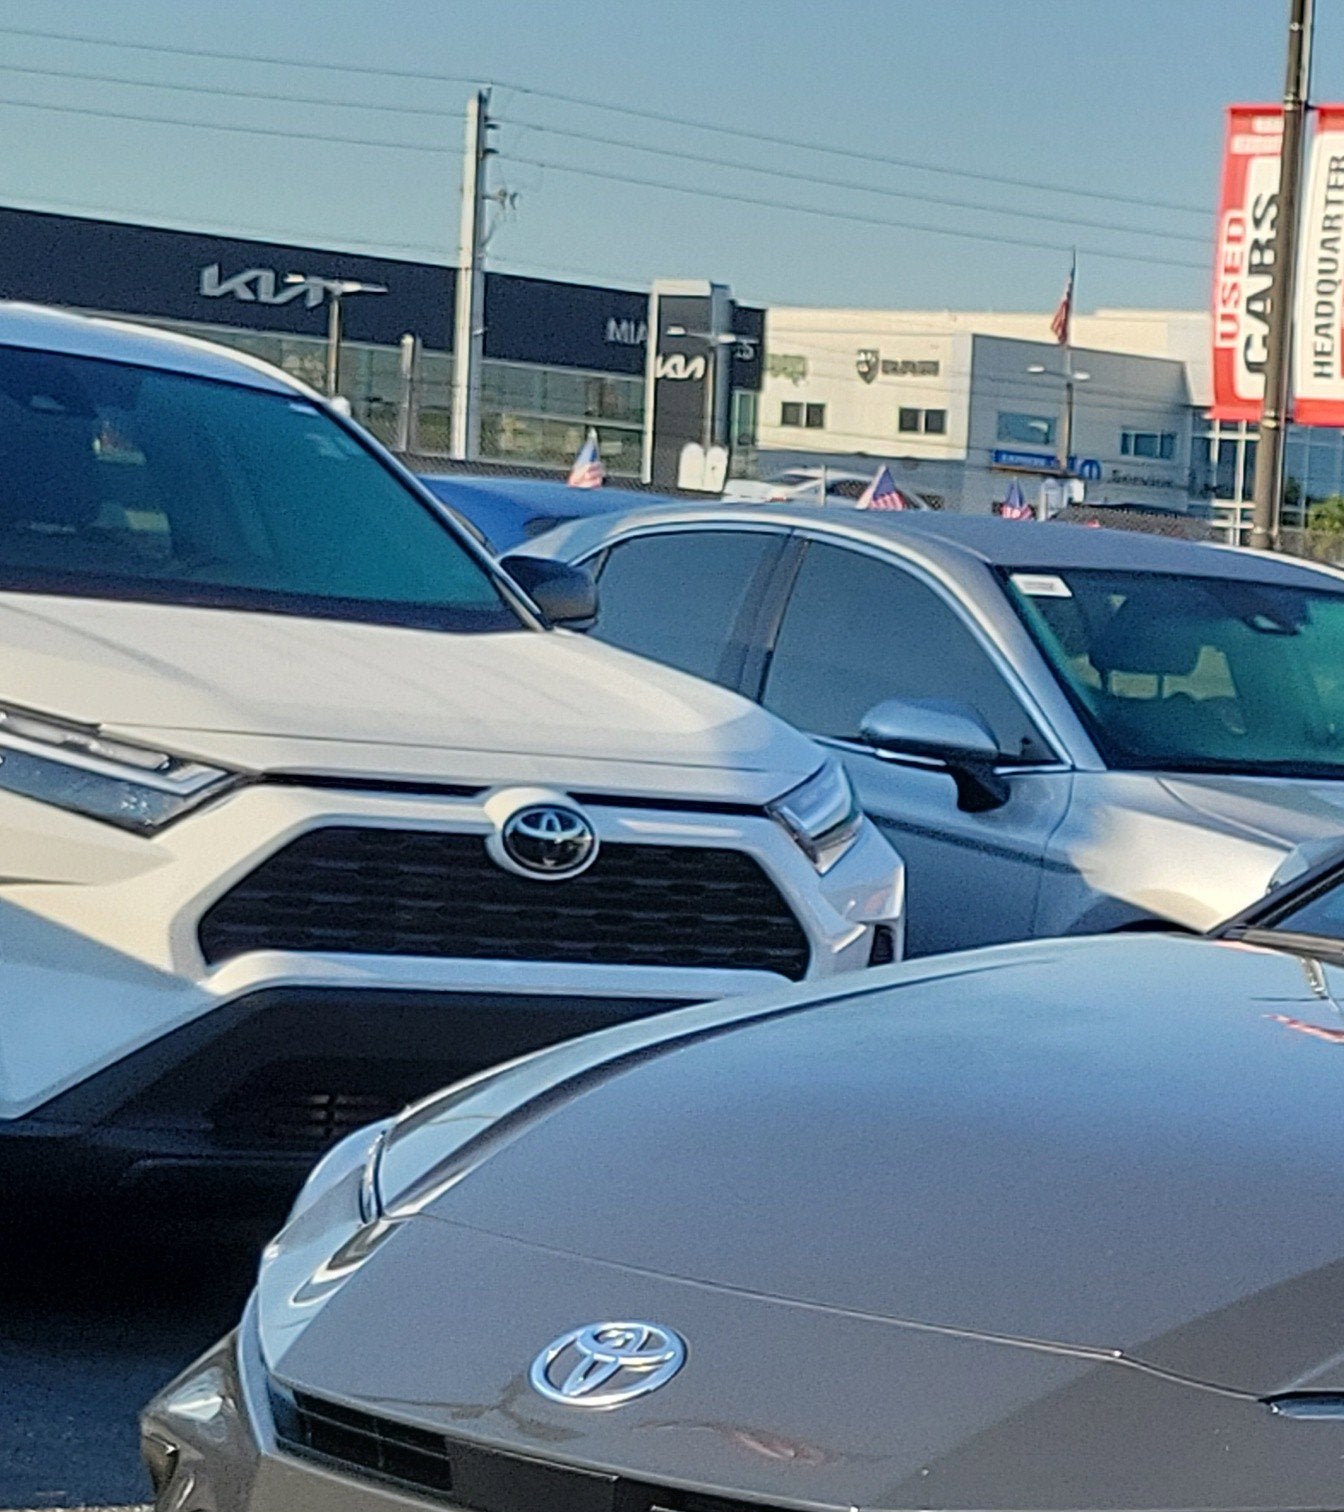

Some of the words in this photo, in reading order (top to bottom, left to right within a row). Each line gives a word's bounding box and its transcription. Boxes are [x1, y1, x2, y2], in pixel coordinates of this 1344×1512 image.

[201, 263, 325, 308] KIA
[1219, 215, 1247, 344] USED
[1242, 192, 1280, 375] CARS
[606, 317, 648, 345] MIA
[655, 354, 707, 380] KIA
